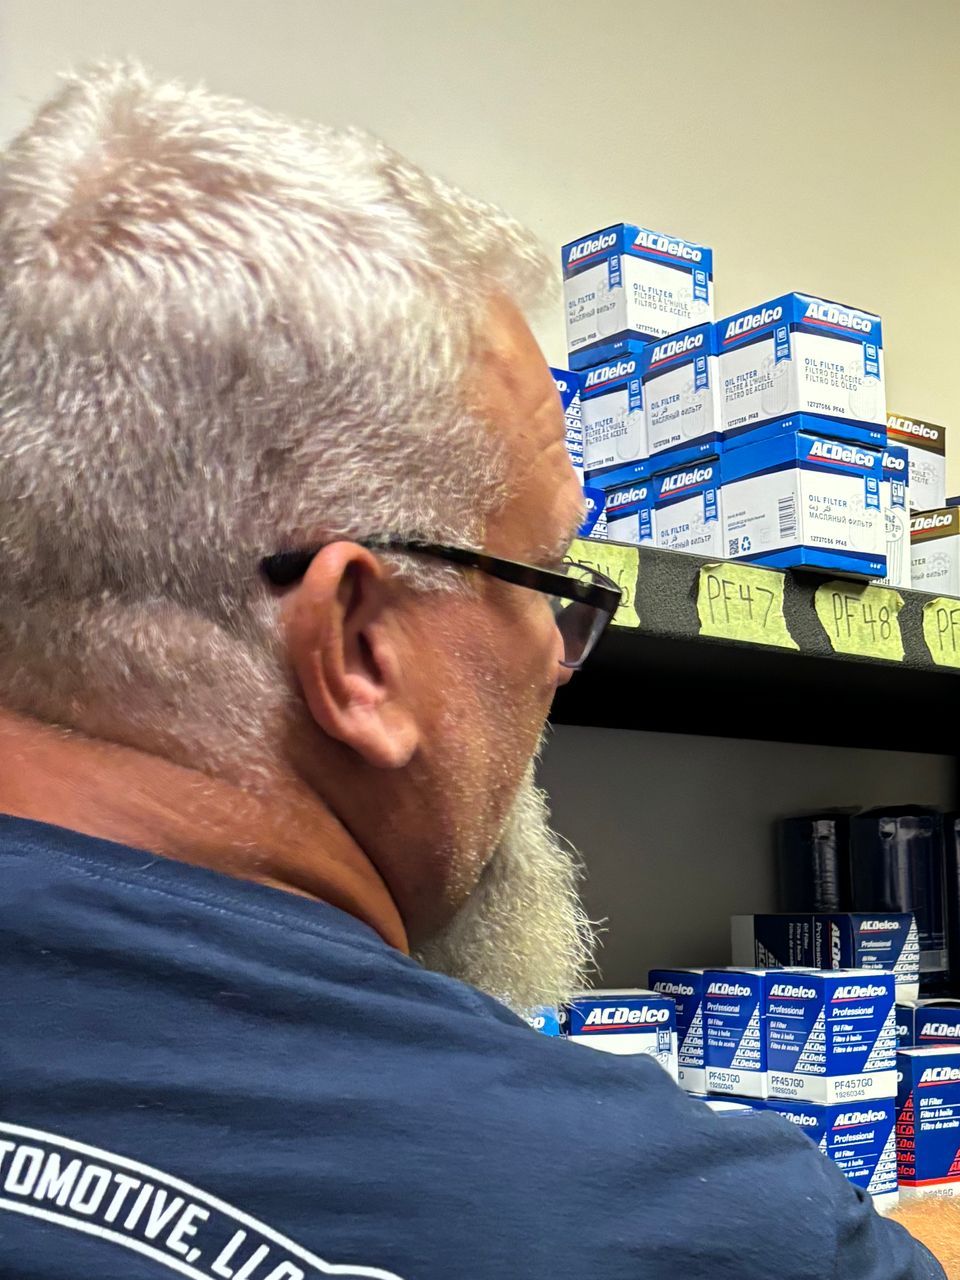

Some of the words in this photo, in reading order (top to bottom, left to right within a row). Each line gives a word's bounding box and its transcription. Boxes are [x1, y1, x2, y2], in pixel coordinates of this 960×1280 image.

[569, 233, 616, 262] ACDelco
[634, 232, 702, 262] ACDelco
[726, 306, 782, 338] ACDelco
[806, 303, 871, 332] ACDelco
[652, 333, 703, 362] ACDelco
[585, 359, 636, 386] ACDelco
[888, 416, 938, 440] ACDelco
[810, 440, 874, 467] ACDelco
[661, 467, 712, 492] ACDelco
[707, 574, 775, 628] PF47
[832, 592, 890, 641] PF48
[860, 920, 899, 931] ACDelco
[861, 940, 891, 949] Professional
[654, 982, 693, 995] ACDelco
[708, 982, 750, 996] ACDelco
[770, 984, 816, 999] ACDelco
[834, 985, 886, 999] ACDelco
[585, 1007, 670, 1025] ACDelco
[707, 1002, 740, 1014] Professional
[770, 1005, 804, 1016] Professional
[833, 1006, 874, 1017] Professional
[834, 1110, 885, 1126] ACDelco
[834, 1130, 874, 1144] Professional
